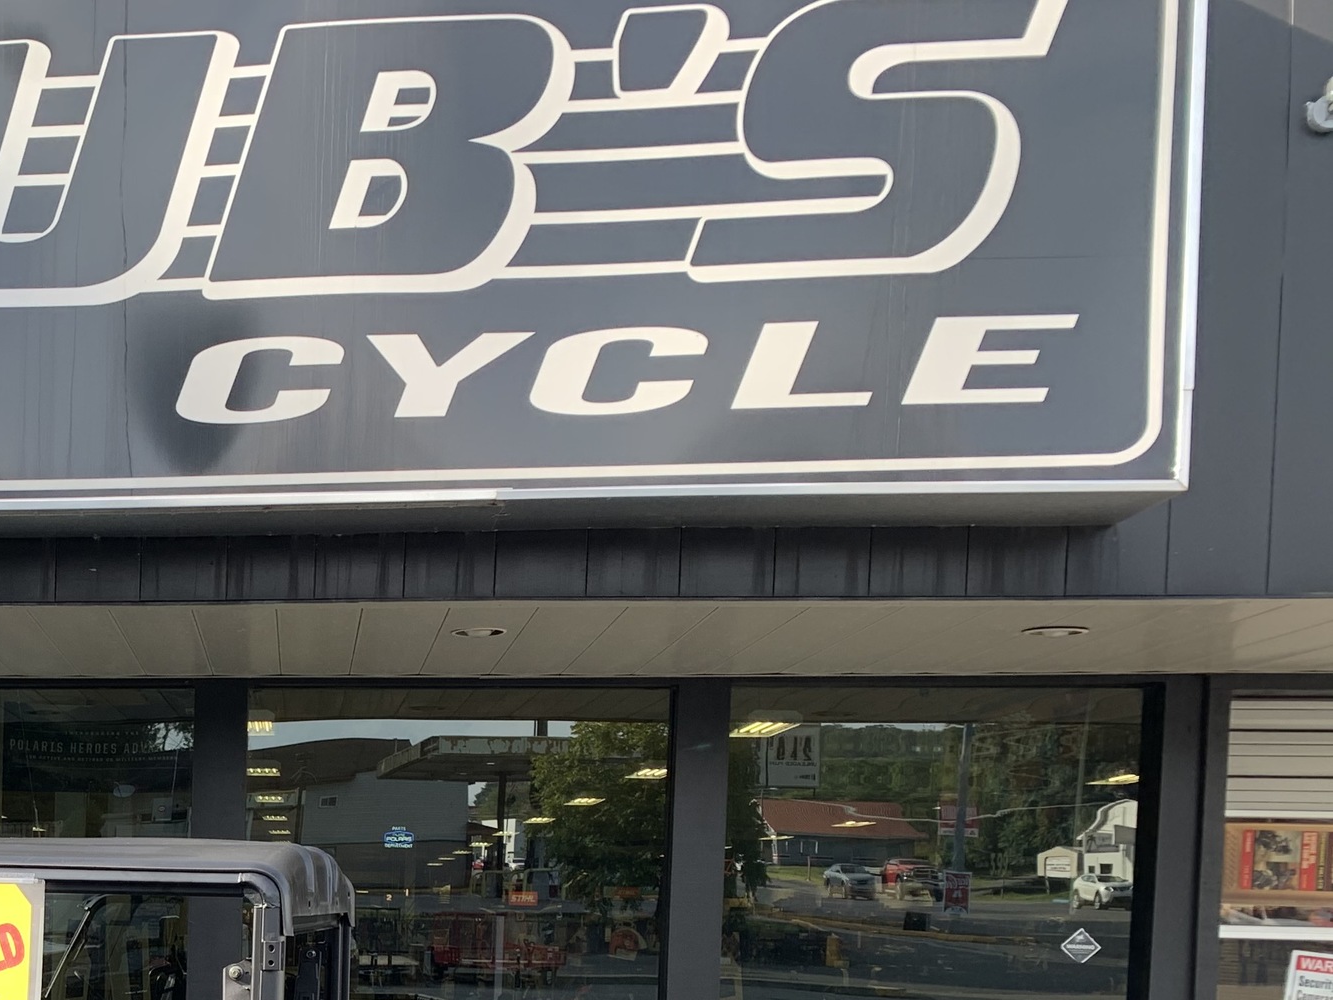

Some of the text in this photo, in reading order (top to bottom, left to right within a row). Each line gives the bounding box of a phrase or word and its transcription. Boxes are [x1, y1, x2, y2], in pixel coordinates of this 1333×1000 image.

[176, 314, 1079, 425] CYCLE
[9, 738, 64, 753] POLARIS
[70, 742, 117, 754] HEROES
[510, 894, 536, 903] STIHL
